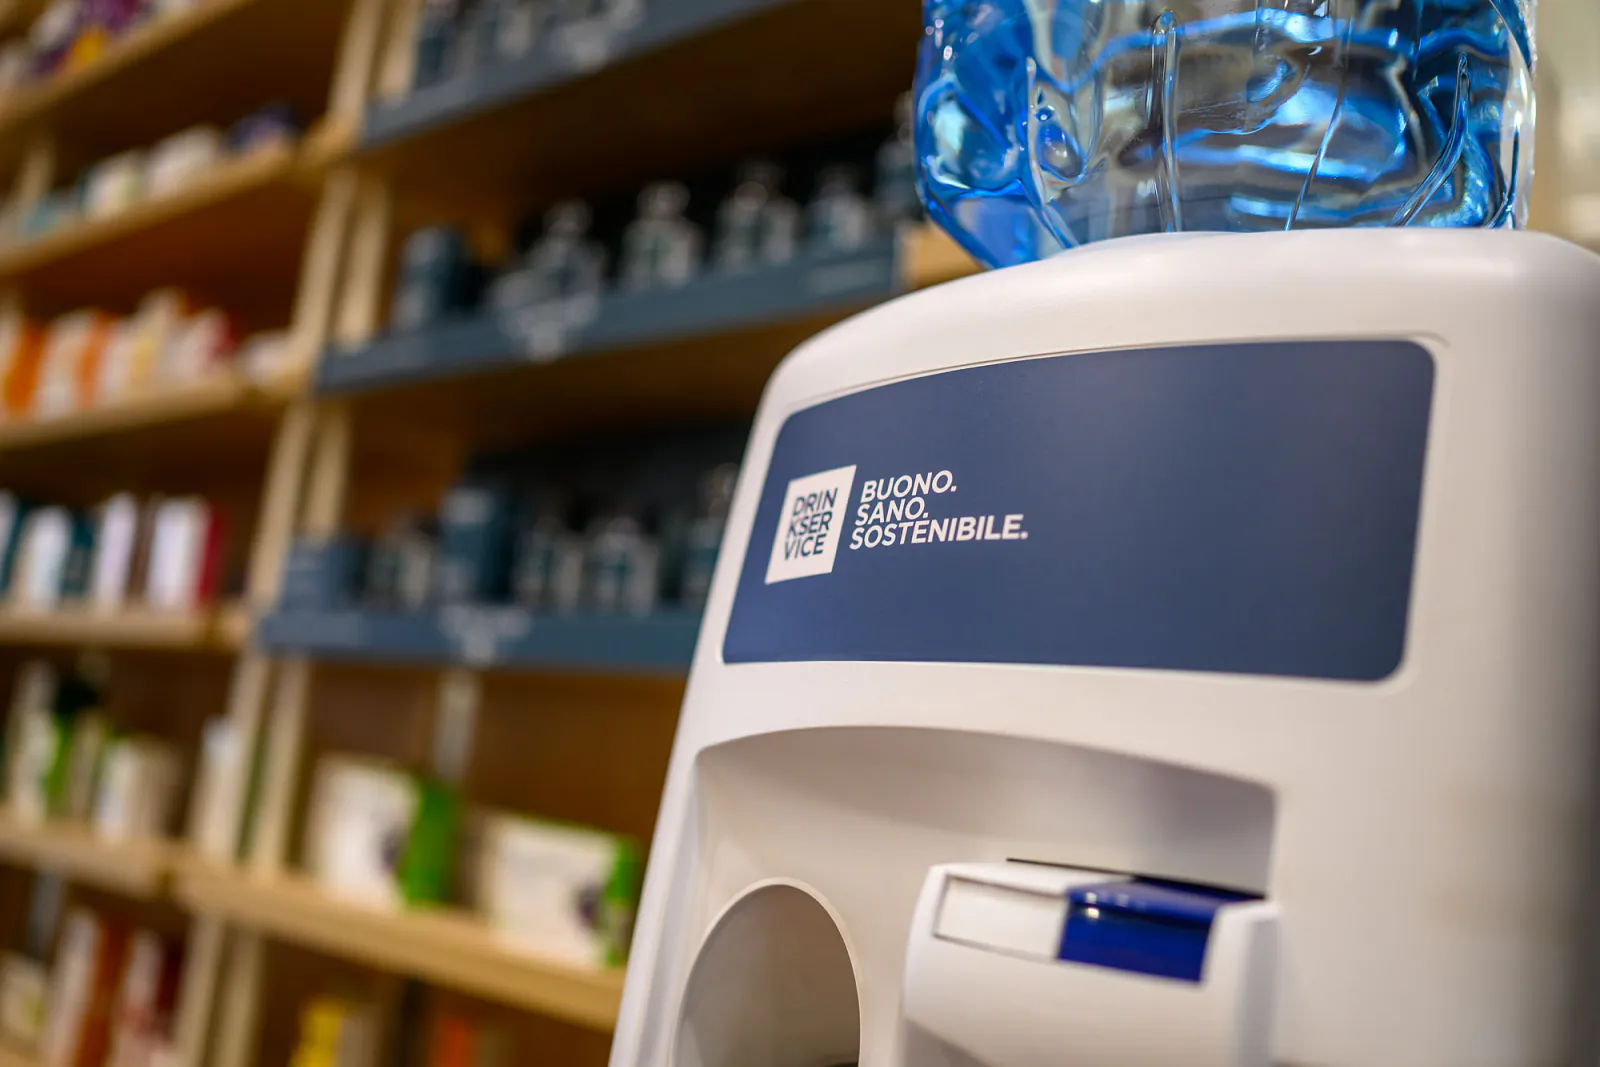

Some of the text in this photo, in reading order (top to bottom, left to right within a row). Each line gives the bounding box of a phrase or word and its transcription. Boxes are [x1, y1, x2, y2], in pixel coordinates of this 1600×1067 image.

[860, 470, 957, 503] BUONO.
[792, 487, 838, 517] DRIN
[855, 497, 928, 526] SANO.
[787, 511, 833, 539] KSER
[849, 514, 1028, 550] SOSTENIBILE.
[784, 533, 827, 561] VICE
